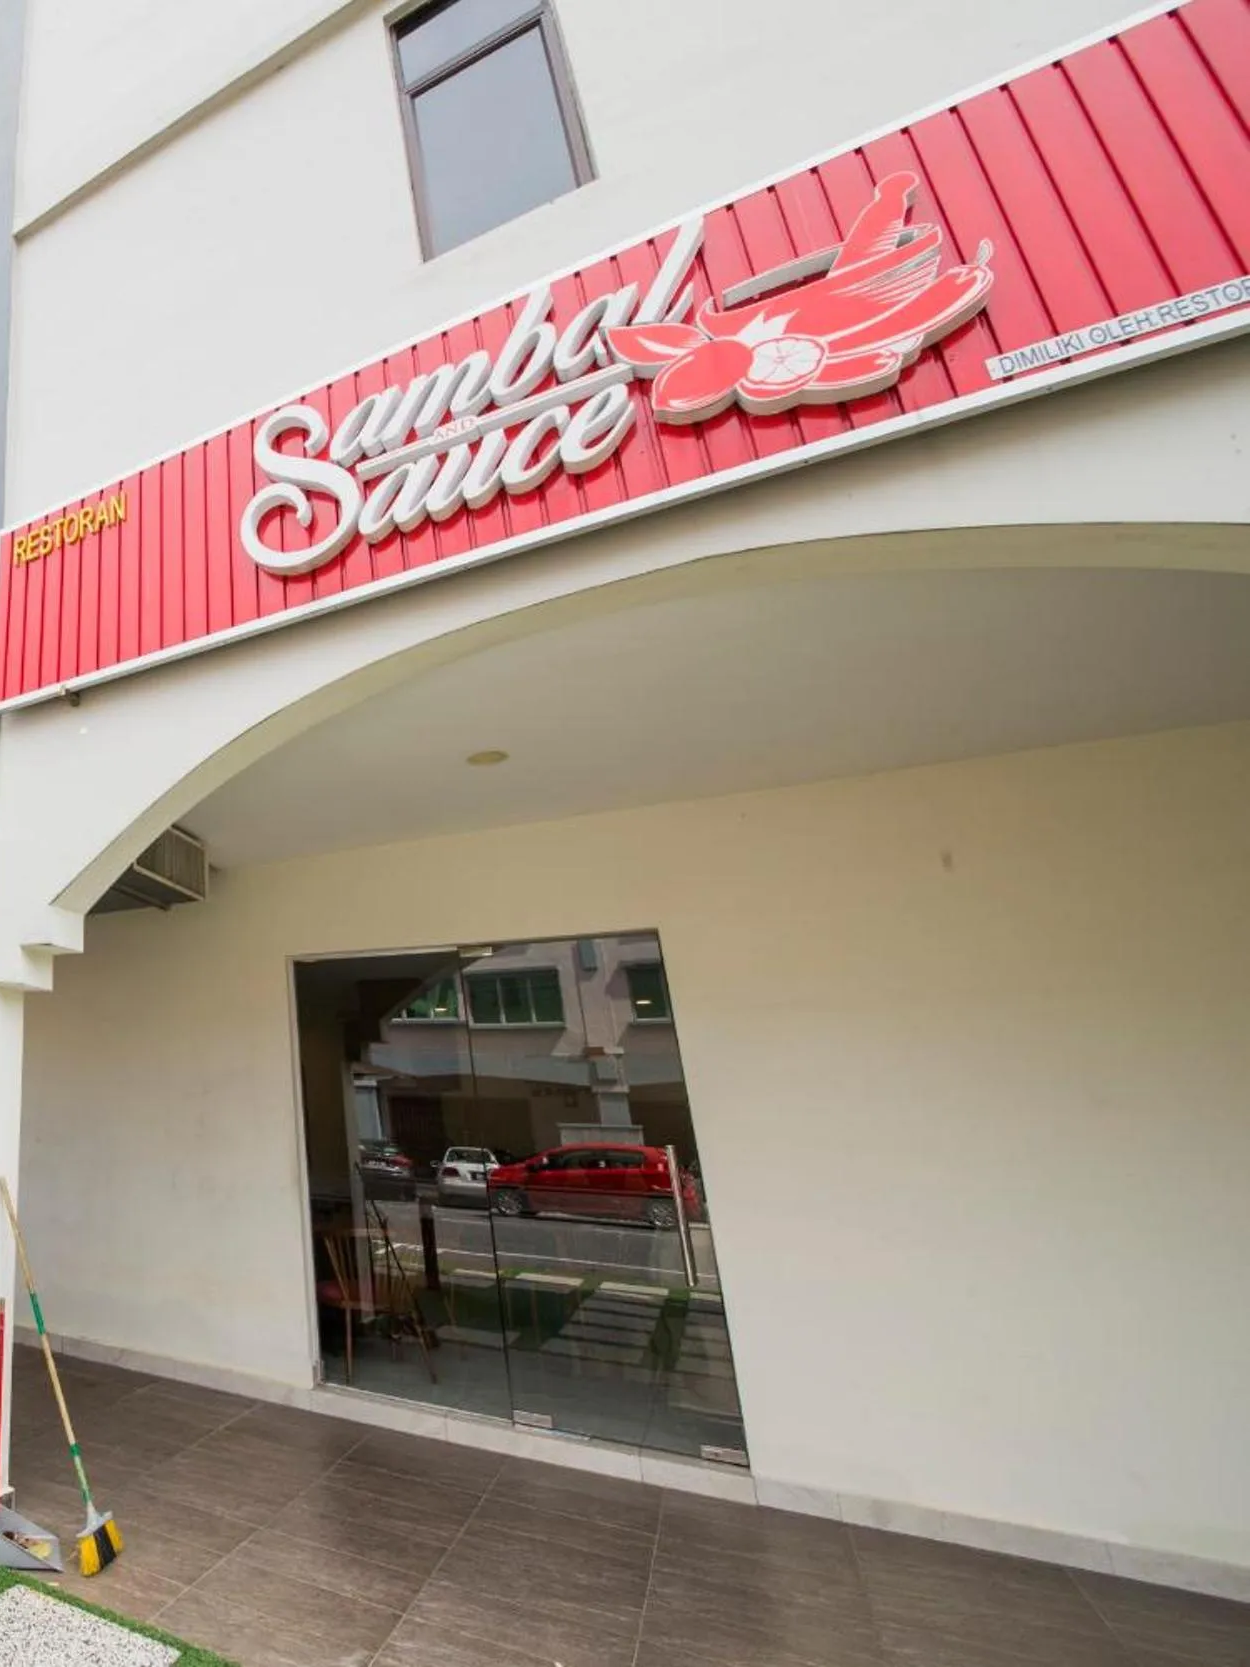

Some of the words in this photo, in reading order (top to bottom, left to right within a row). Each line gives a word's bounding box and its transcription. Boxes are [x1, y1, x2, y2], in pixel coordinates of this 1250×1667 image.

[250, 216, 704, 510] Sambal
[1000, 332, 1085, 375] DIMILIKI
[1089, 313, 1153, 345] OLEH
[433, 417, 477, 441] AND
[239, 382, 636, 576] Sauce
[13, 490, 128, 568] RESTORAN
